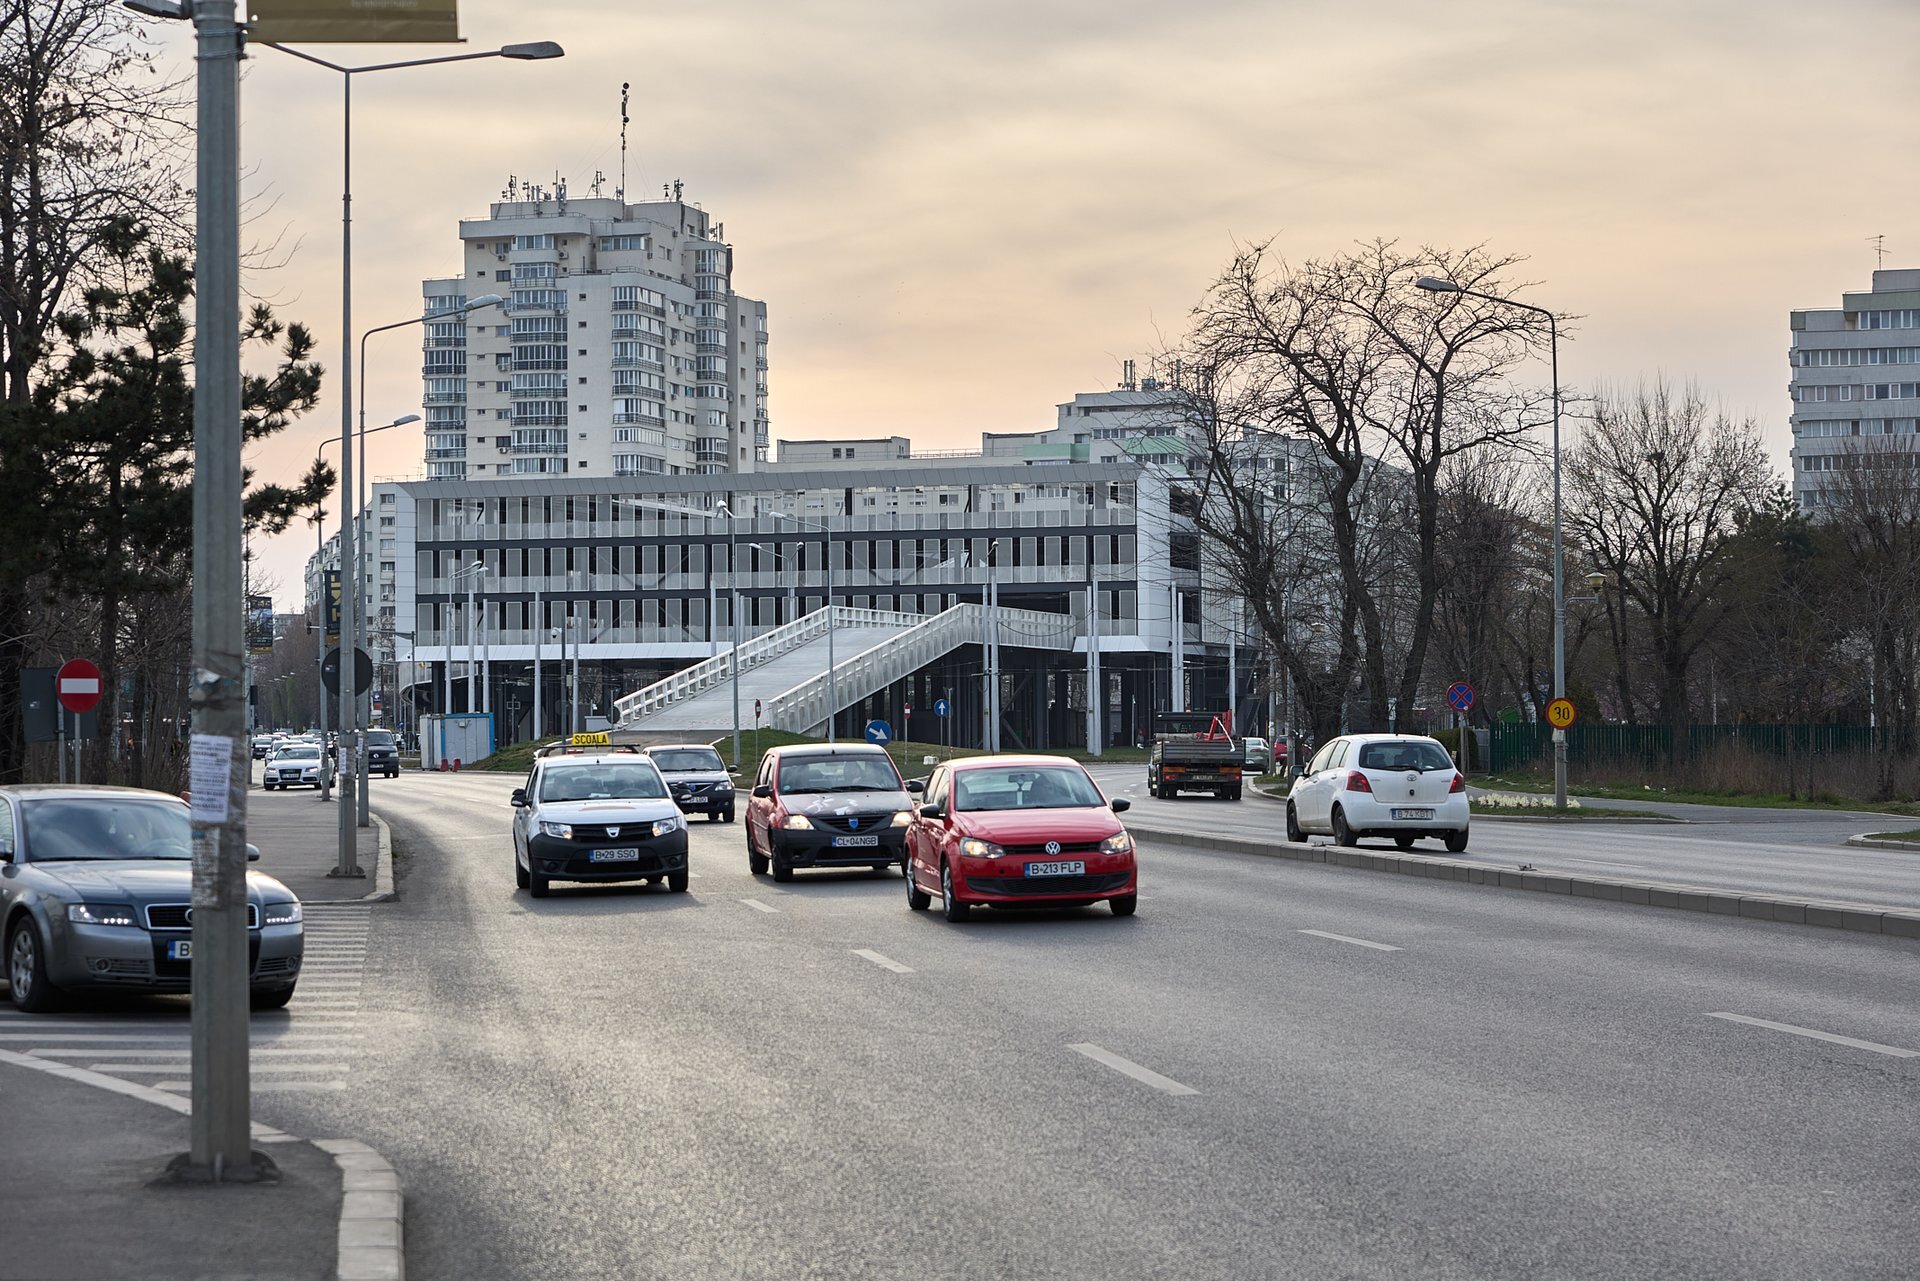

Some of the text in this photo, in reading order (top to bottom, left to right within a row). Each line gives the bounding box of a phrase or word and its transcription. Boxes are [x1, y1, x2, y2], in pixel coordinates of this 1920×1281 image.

[1554, 706, 1570, 720] 30
[574, 734, 608, 745] SCOALA
[1060, 862, 1082, 873] FLP
